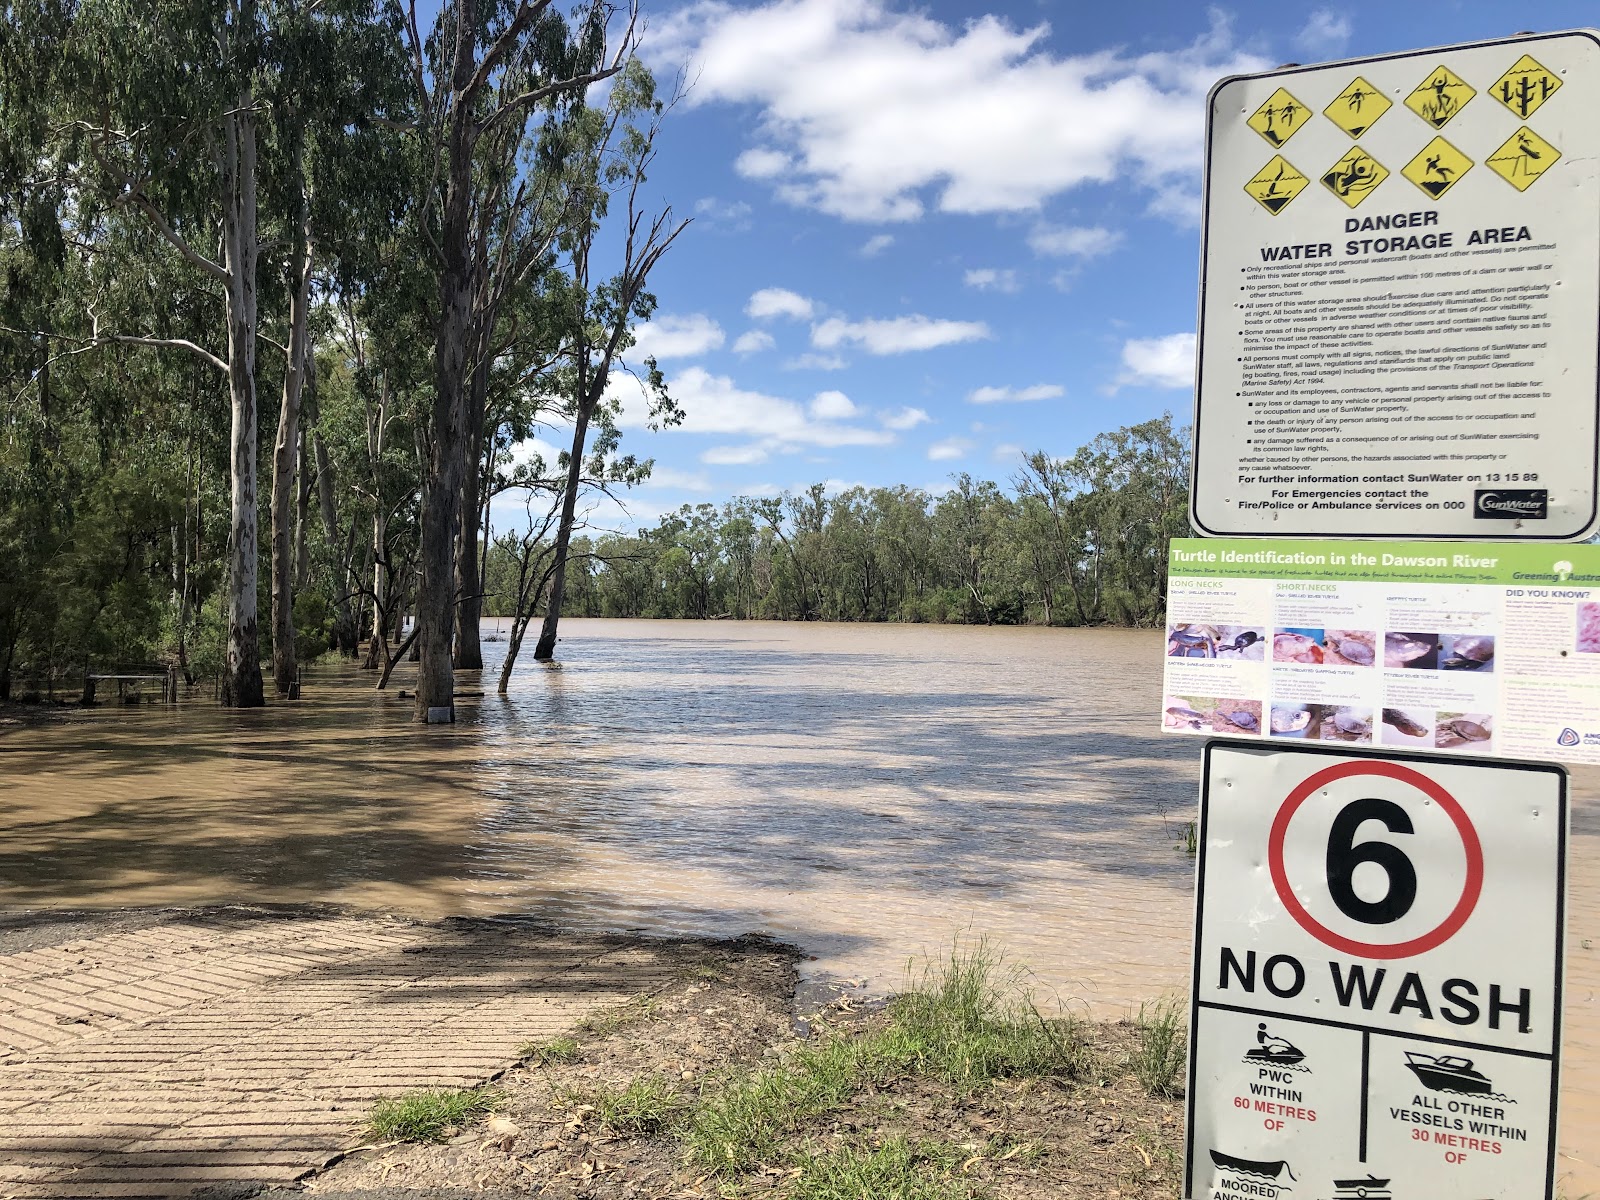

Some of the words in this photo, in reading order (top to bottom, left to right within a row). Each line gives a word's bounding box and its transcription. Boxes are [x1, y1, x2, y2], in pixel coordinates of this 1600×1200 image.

[1345, 211, 1438, 234] DANGER
[1260, 243, 1332, 262] WATER
[1345, 232, 1453, 256] STORAGE
[1467, 226, 1532, 246] AREA
[1246, 272, 1266, 280] within
[1281, 270, 1300, 278] water
[1301, 268, 1328, 278] storage
[1243, 343, 1273, 352] minimise
[1286, 342, 1310, 351] impact
[1241, 379, 1267, 388] (Marine
[1268, 378, 1292, 387] Safety)
[1384, 384, 1410, 393] agents
[1263, 407, 1301, 416] occupation
[1267, 436, 1295, 445] damage
[1409, 434, 1435, 443] arising
[1499, 432, 1540, 441] exercising
[1291, 455, 1300, 463] by
[1464, 453, 1498, 462] property
[1238, 475, 1255, 483] For
[1258, 475, 1294, 483] further
[1298, 474, 1359, 483] information
[1362, 474, 1404, 482] contact
[1408, 474, 1463, 482] SunWater
[1486, 474, 1501, 482] 13
[1505, 474, 1519, 482] 15
[1523, 474, 1539, 482] 89
[1272, 490, 1289, 498] For
[1292, 490, 1362, 499] Emergencies
[1365, 490, 1407, 498] contact
[1410, 490, 1429, 498] the
[1238, 501, 1294, 511] Fire/Police
[1312, 501, 1372, 509] Ambulance
[1375, 501, 1422, 510] services
[1443, 502, 1466, 510] 000
[1485, 500, 1543, 509] SunWater
[1172, 550, 1216, 562] Turtle
[1221, 551, 1325, 564] Identification
[1331, 552, 1345, 564] in
[1351, 553, 1376, 565] the
[1382, 554, 1447, 567] Dawson
[1453, 555, 1498, 567] River
[1513, 572, 1559, 582] Greening
[1326, 798, 1417, 924] 6
[1219, 946, 1305, 999] NO
[1328, 962, 1530, 1034] WASH
[1258, 1069, 1293, 1084] PWC
[1249, 1083, 1302, 1103] WITHIN
[1234, 1097, 1250, 1109] 60
[1254, 1100, 1316, 1122] METRES
[1412, 1095, 1442, 1110] ALL
[1448, 1101, 1505, 1120] OTHER
[1264, 1119, 1284, 1132] OF
[1390, 1108, 1464, 1130] VESSELS
[1469, 1121, 1526, 1141] WITHIN
[1412, 1129, 1429, 1141] 30
[1434, 1132, 1502, 1154] METRES
[1445, 1151, 1467, 1165] OF
[1222, 1179, 1279, 1200] MOORED/
